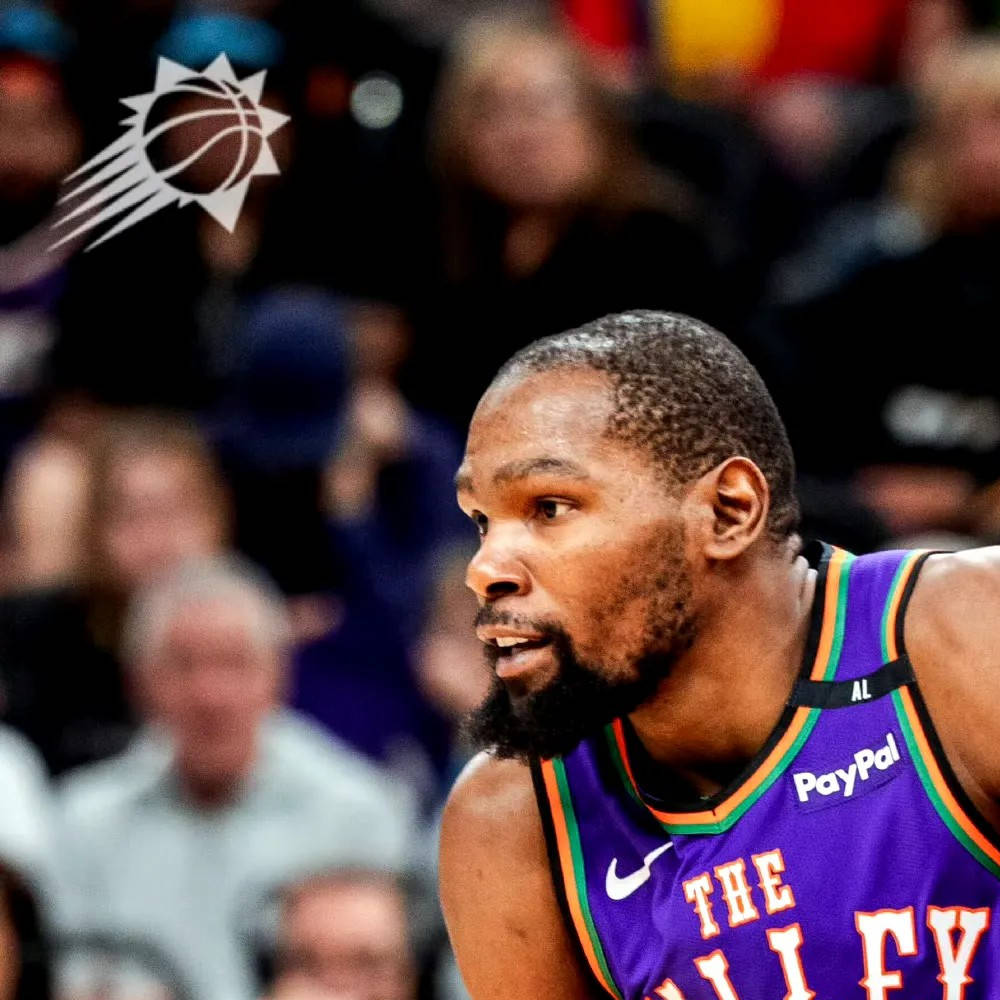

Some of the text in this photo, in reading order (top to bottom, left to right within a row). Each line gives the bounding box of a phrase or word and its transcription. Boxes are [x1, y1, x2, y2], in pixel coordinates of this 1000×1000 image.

[851, 678, 872, 702] AL
[793, 732, 901, 802] PayPal
[682, 848, 796, 940] THE
